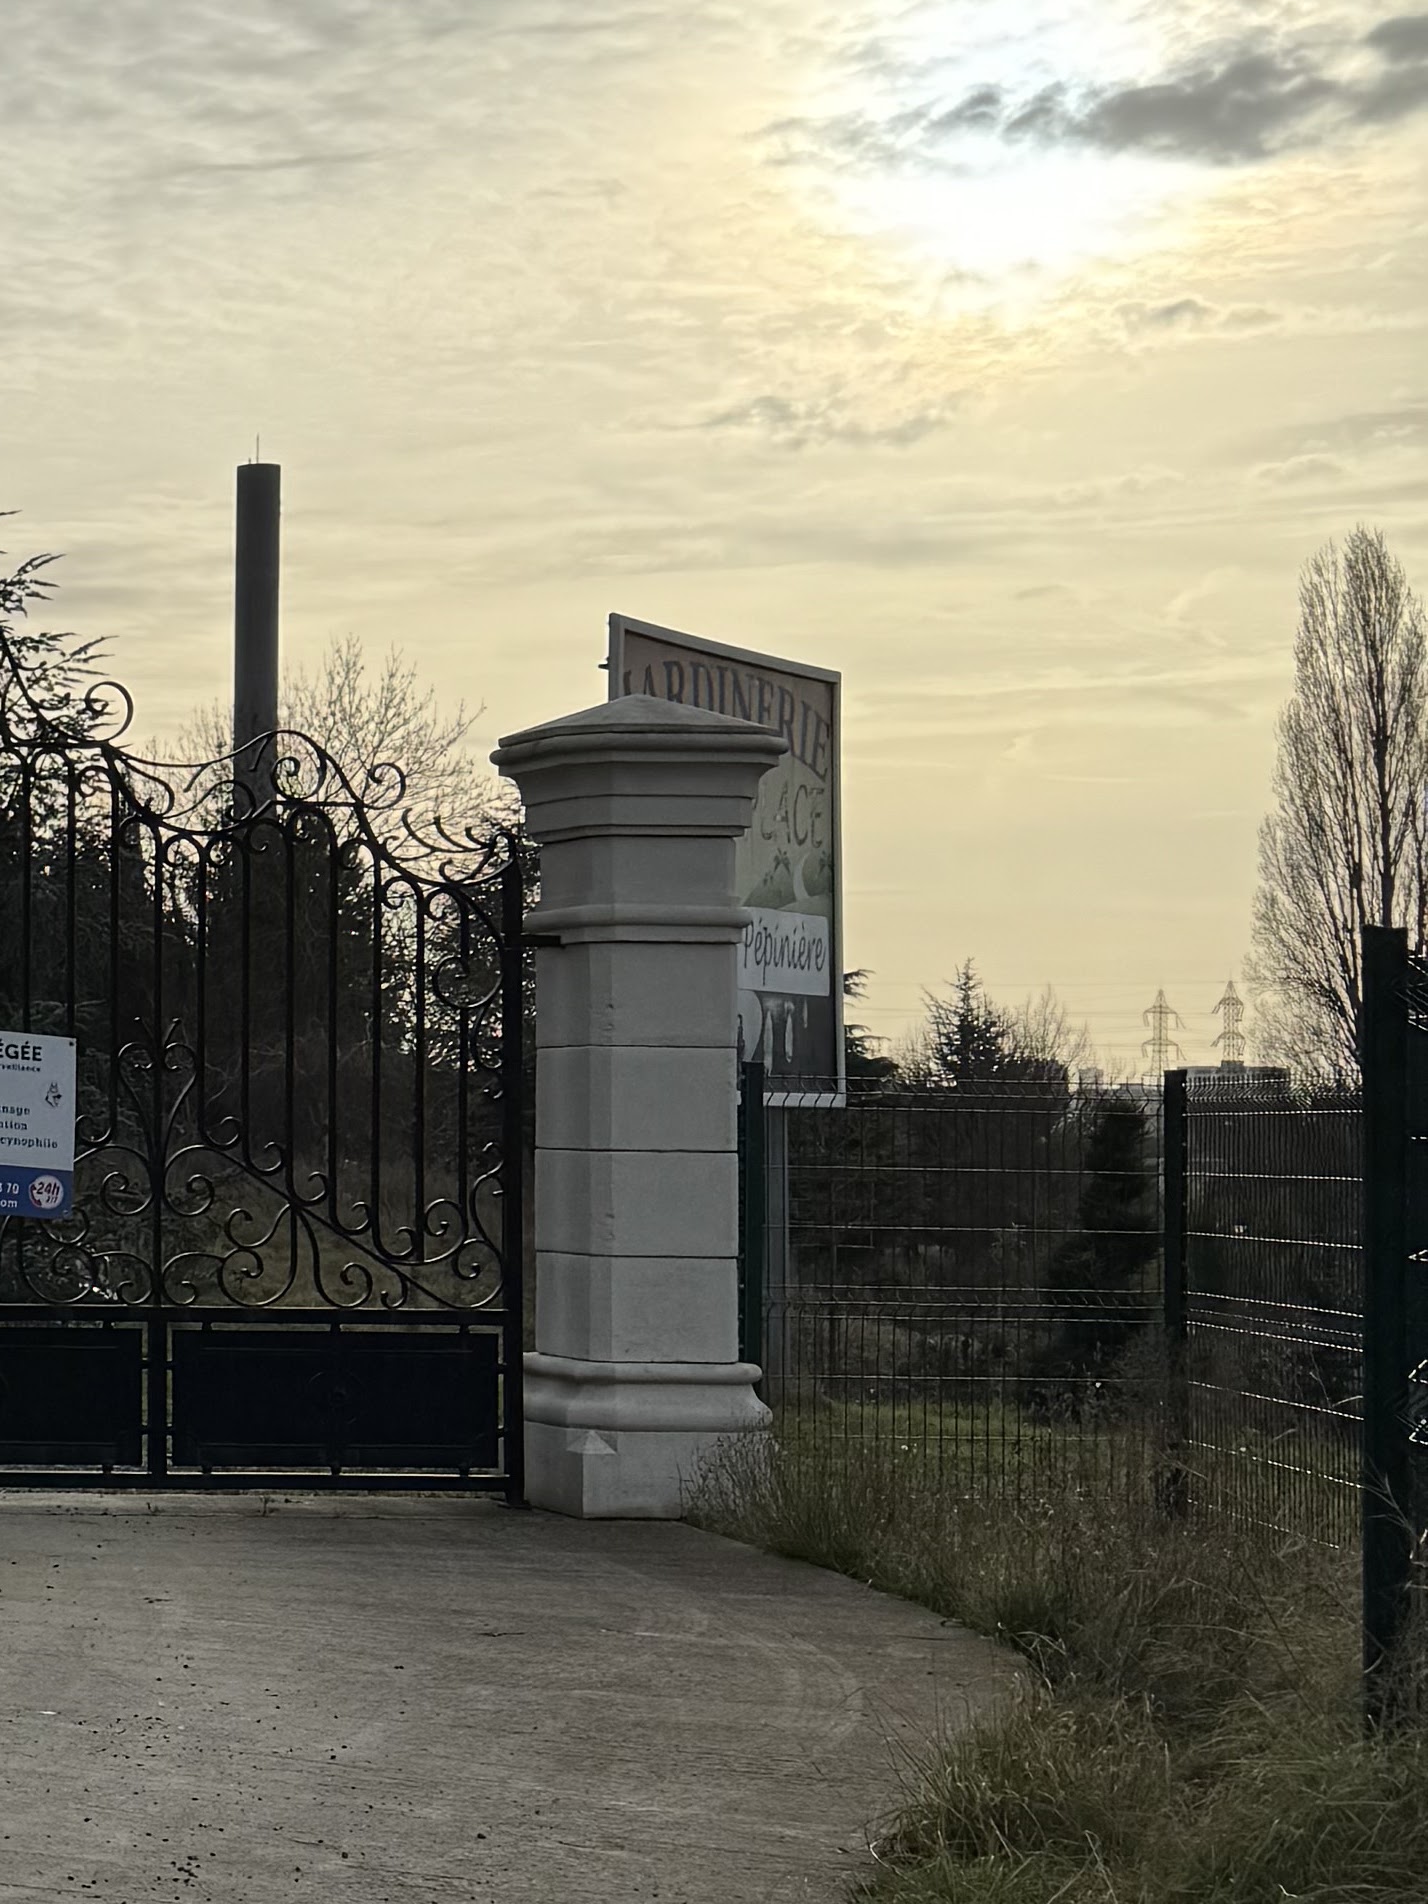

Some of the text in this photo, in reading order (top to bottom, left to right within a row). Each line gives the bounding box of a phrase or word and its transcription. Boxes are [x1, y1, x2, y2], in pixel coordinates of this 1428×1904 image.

[743, 916, 827, 986] Pépinière
[6, 1182, 20, 1195] 70
[36, 1181, 60, 1196] 24h
